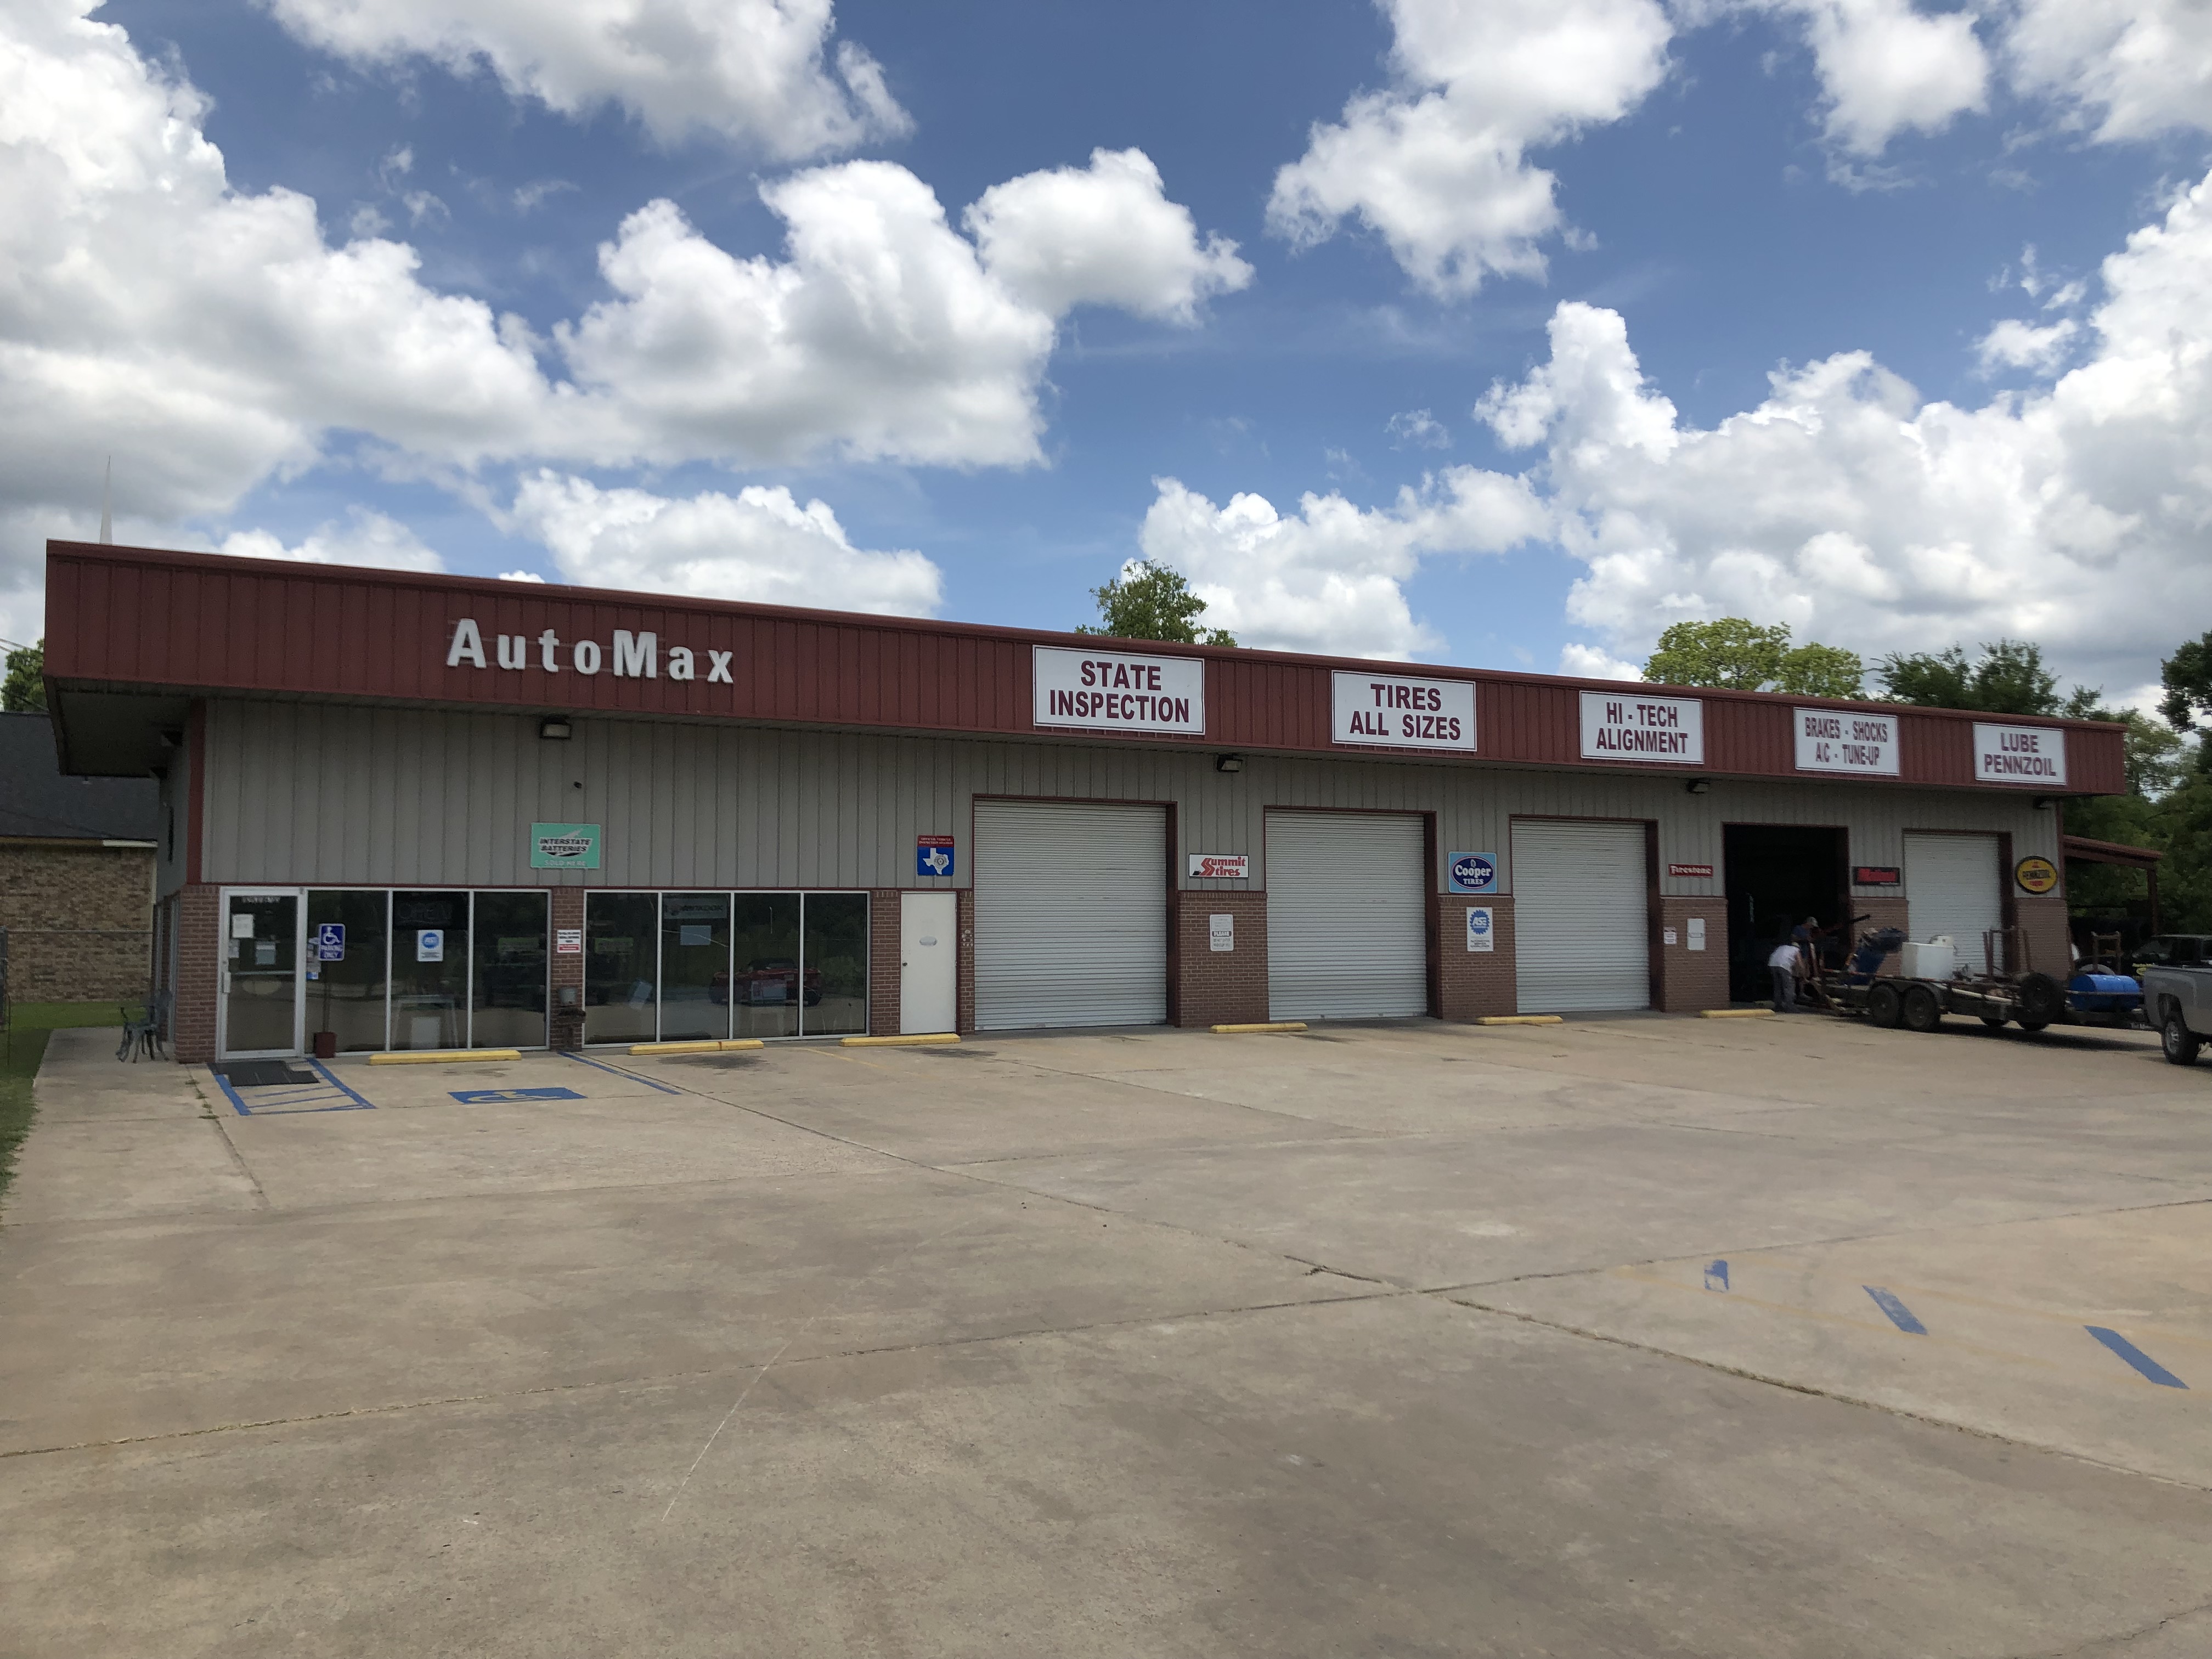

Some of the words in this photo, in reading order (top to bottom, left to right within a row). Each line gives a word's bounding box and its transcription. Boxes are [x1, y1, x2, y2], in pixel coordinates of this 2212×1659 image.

[447, 618, 733, 683] AutoMax
[1081, 661, 1161, 691] STATE
[1050, 690, 1189, 723] INSPECTION
[1370, 683, 1441, 712] TIRES
[1350, 710, 1389, 736] ALL
[1402, 714, 1460, 740] SIZES
[1805, 716, 1840, 739] BRAKES
[1853, 720, 1888, 743] SHOCKS
[1596, 727, 1688, 754] ALIGNMENT
[2000, 732, 2040, 753] LUBE
[1842, 744, 1880, 765] TUNE-UP
[1984, 754, 2057, 776] PENNZOIL
[1200, 856, 1246, 876] Summit
[1215, 865, 1240, 876] tires
[1455, 865, 1492, 878] Cooper
